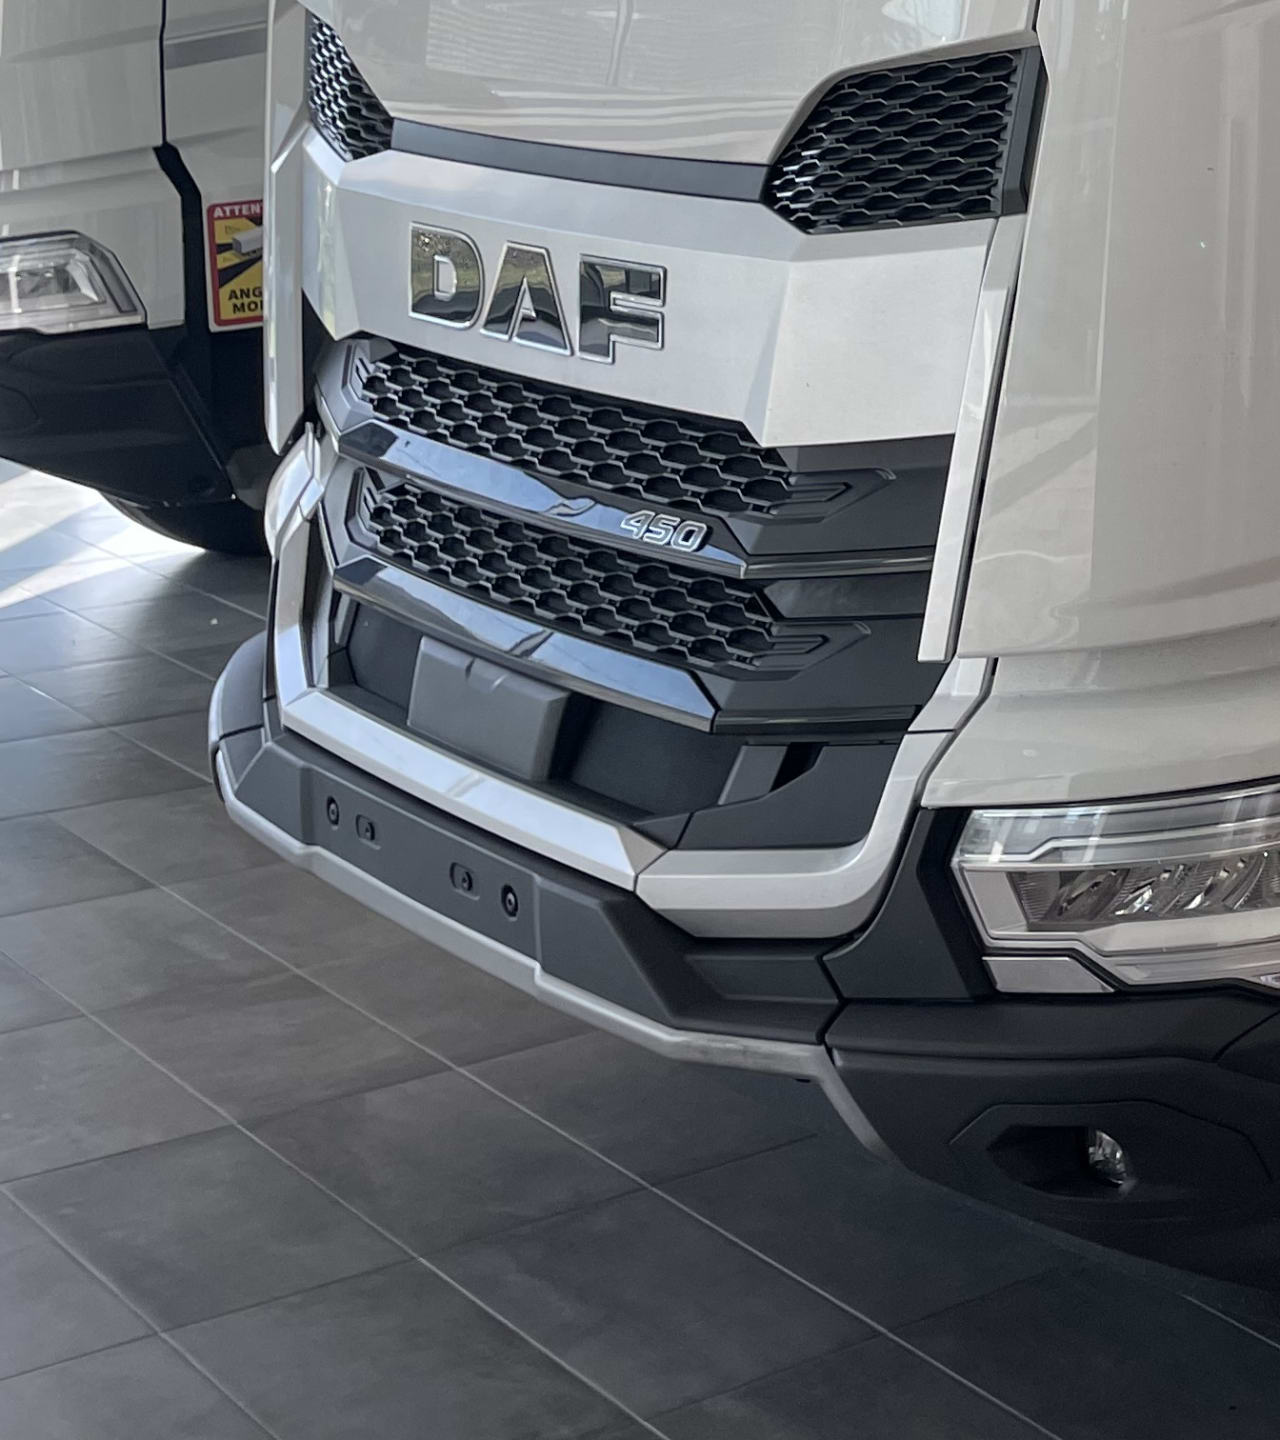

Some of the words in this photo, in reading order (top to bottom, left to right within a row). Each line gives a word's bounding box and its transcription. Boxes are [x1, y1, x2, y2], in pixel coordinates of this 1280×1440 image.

[213, 203, 263, 218] ATTEN
[408, 221, 667, 365] DAF
[620, 509, 709, 553] 450
